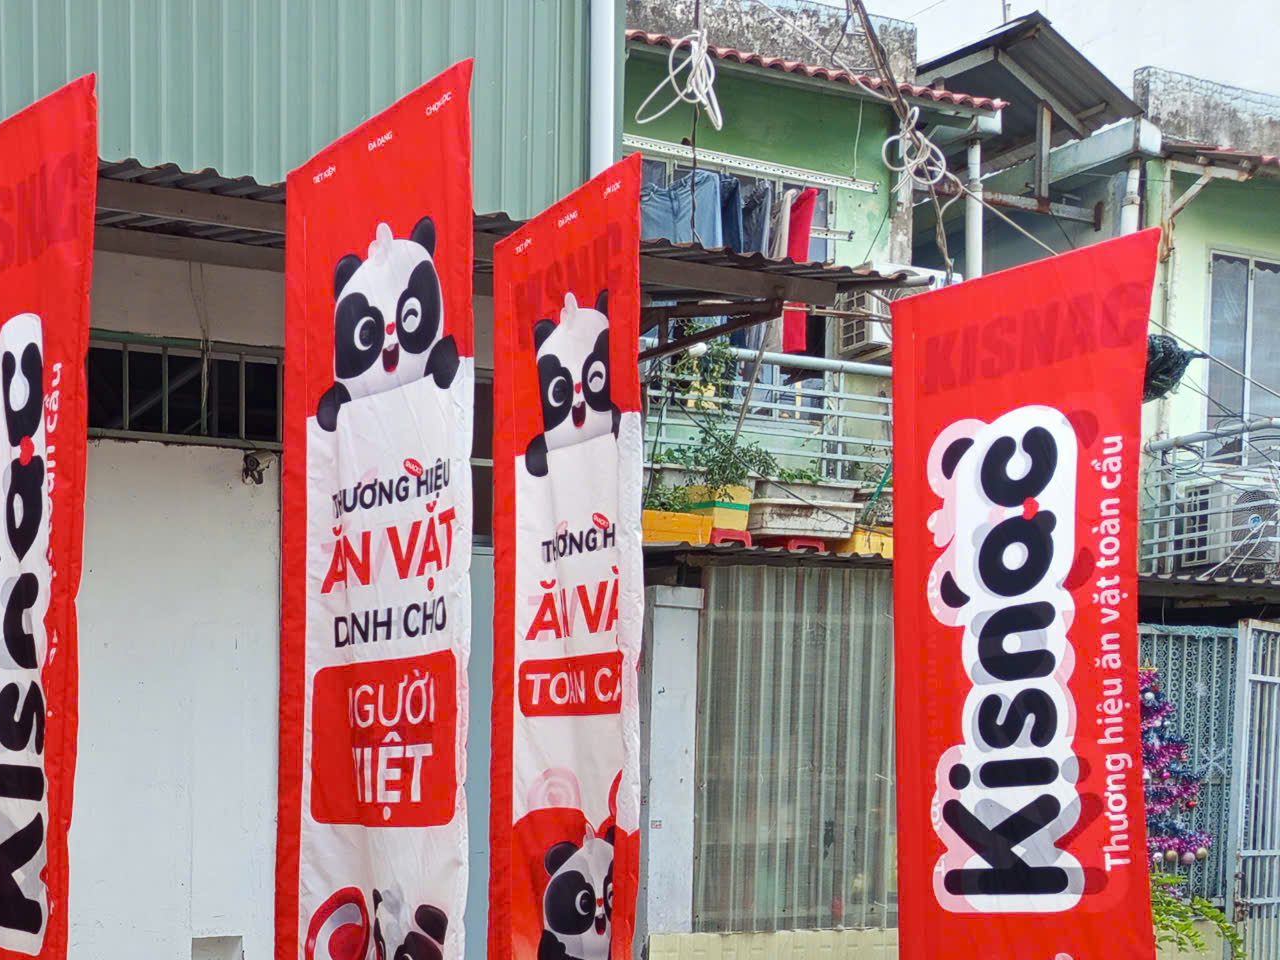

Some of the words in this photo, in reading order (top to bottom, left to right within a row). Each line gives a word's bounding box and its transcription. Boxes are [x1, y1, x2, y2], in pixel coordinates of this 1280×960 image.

[1091, 435, 1123, 489] cầu
[1092, 498, 1121, 568] toàn
[1092, 576, 1129, 624] vặt
[1094, 632, 1121, 669] ăn
[1096, 678, 1131, 745] hiệu
[1101, 752, 1133, 871] Thương
